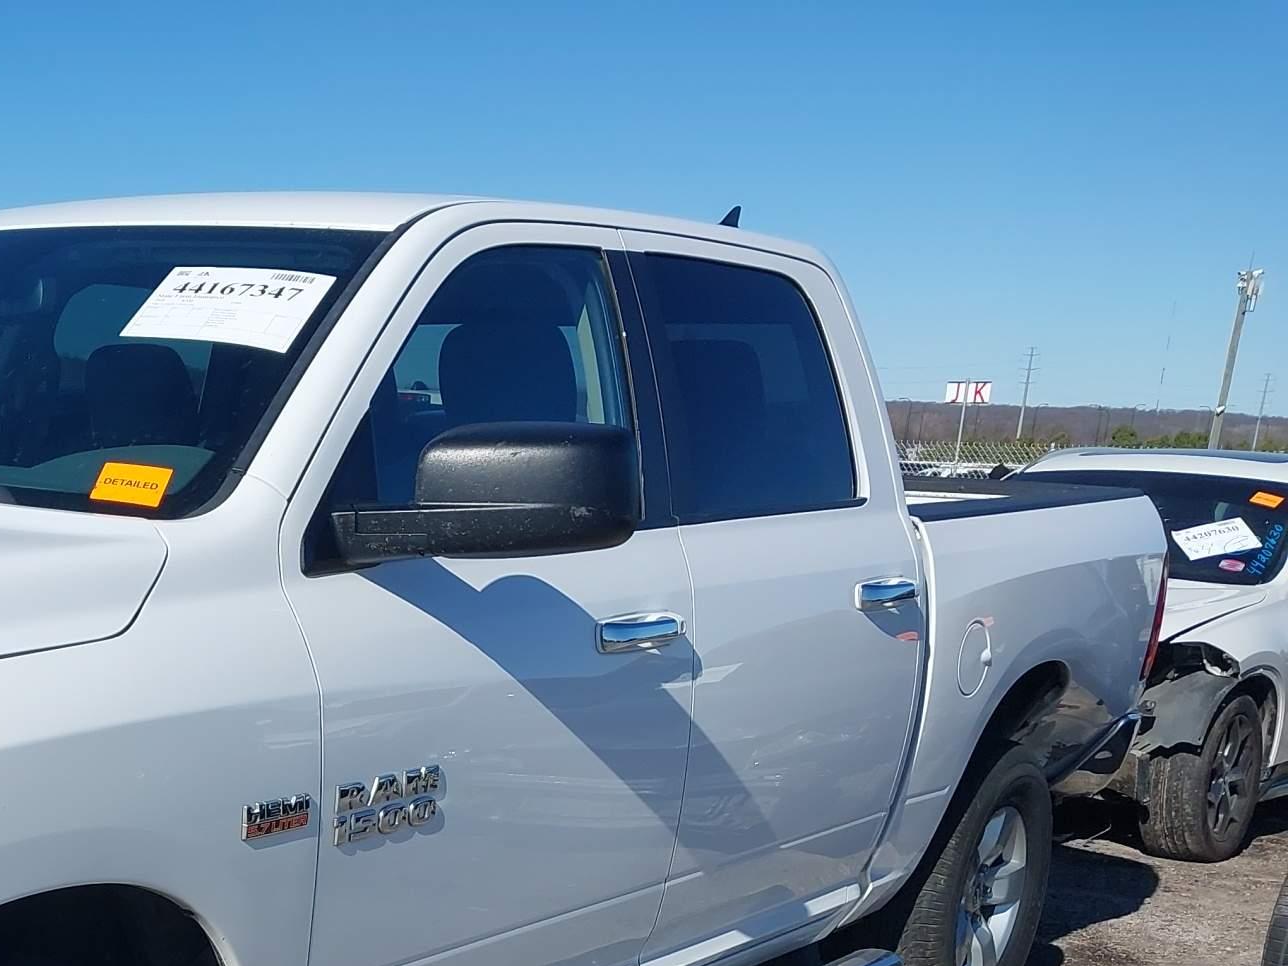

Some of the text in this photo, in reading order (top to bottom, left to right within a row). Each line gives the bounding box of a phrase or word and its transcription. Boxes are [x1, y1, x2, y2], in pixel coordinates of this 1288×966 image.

[173, 281, 304, 301] 44167347
[103, 476, 159, 491] DETAILED
[334, 764, 441, 816] RAM
[242, 792, 311, 825] HEMI
[332, 795, 439, 847] 1500
[271, 813, 309, 833] LITER
